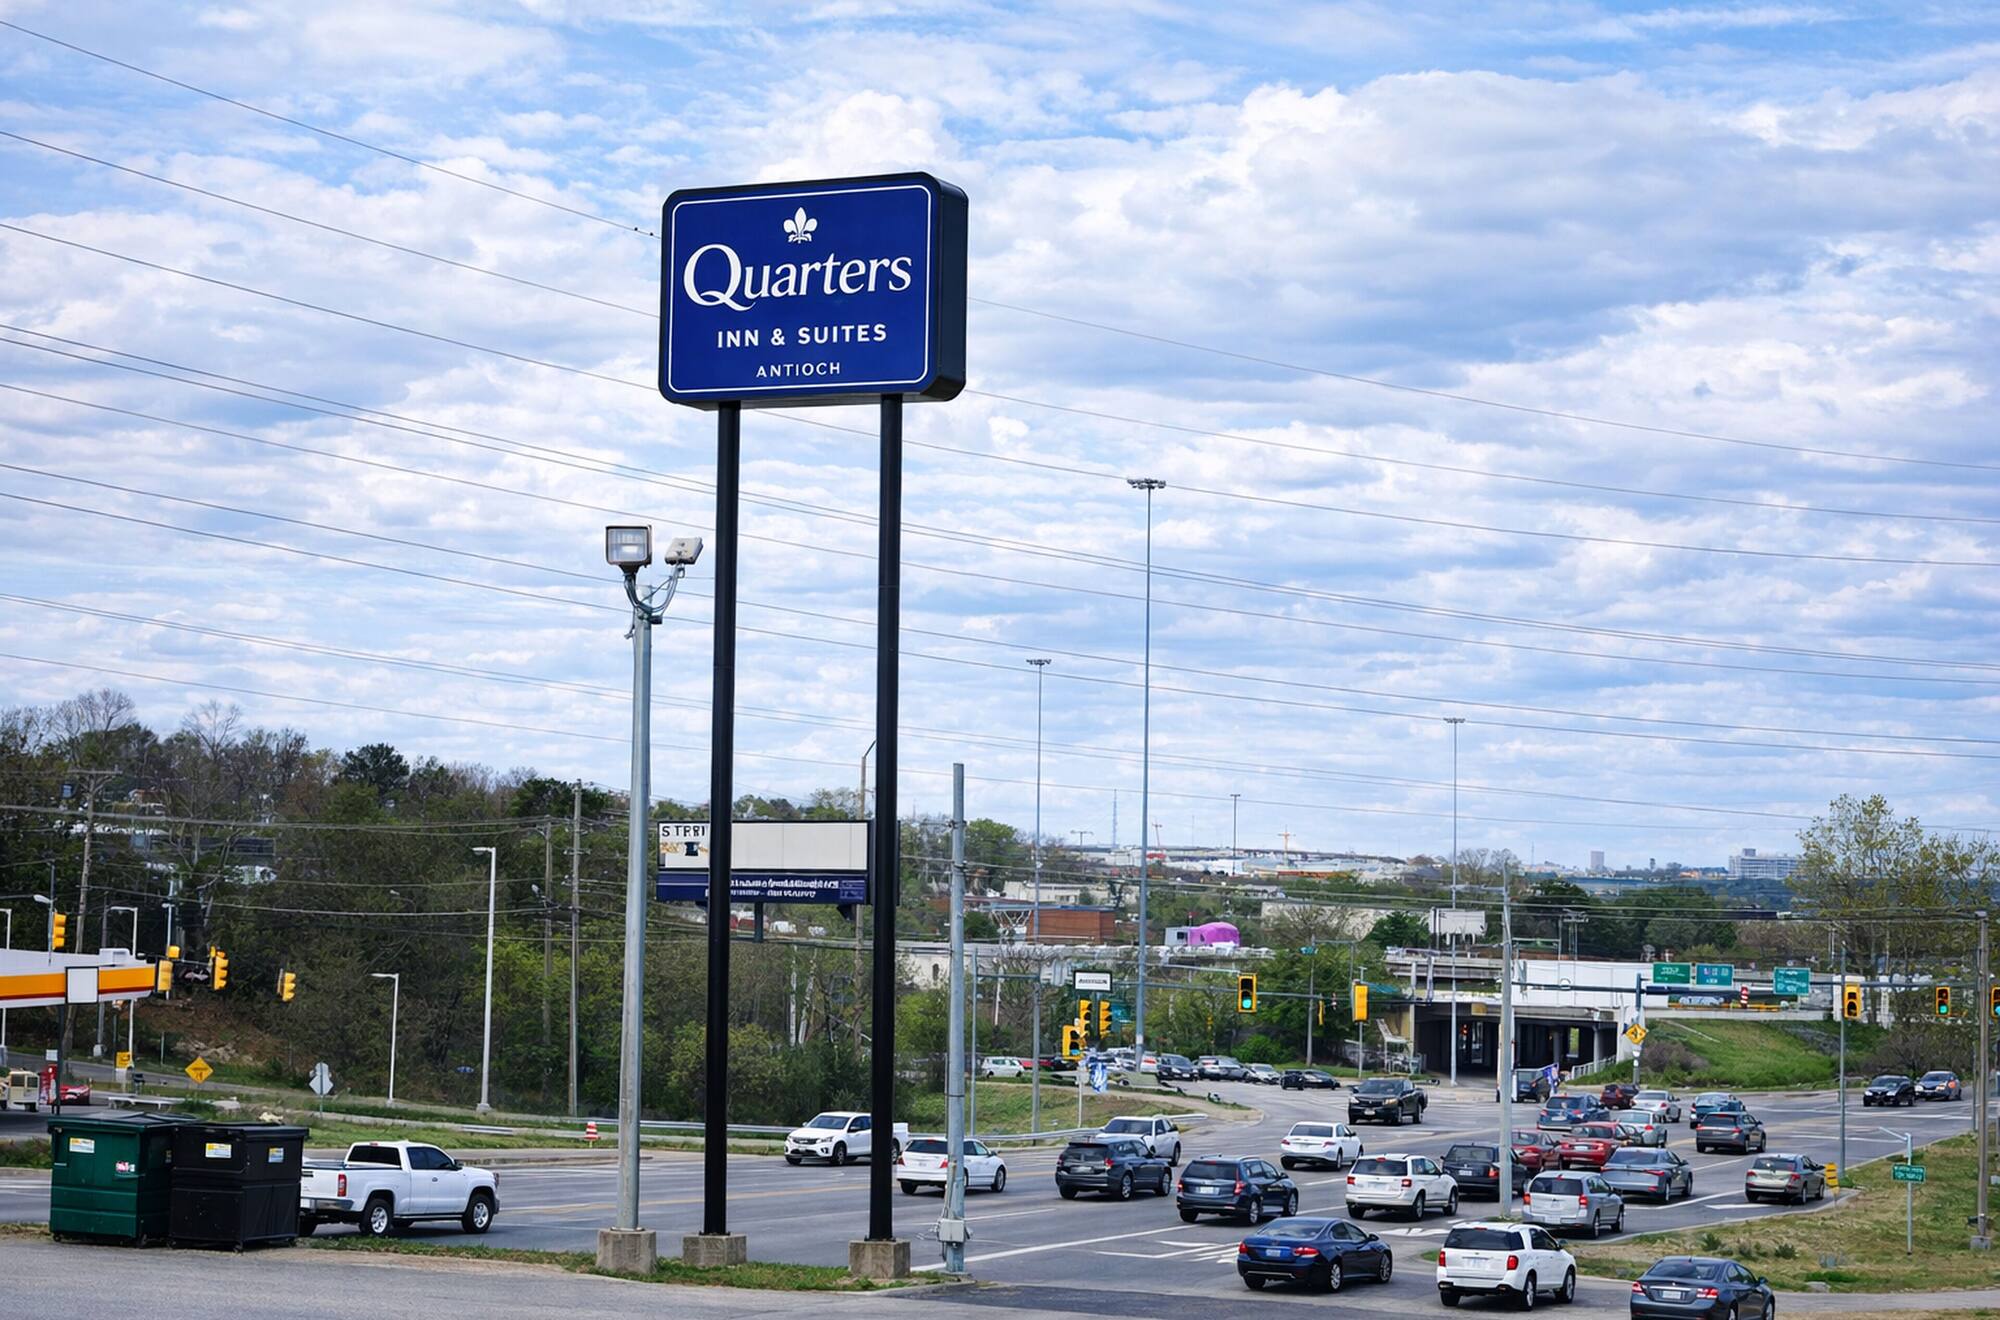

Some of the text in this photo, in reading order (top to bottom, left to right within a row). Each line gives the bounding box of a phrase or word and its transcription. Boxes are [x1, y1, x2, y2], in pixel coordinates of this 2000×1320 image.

[683, 244, 913, 312] Quarters
[717, 323, 888, 349] INN & SUITES
[756, 362, 841, 378] ANTIOCH
